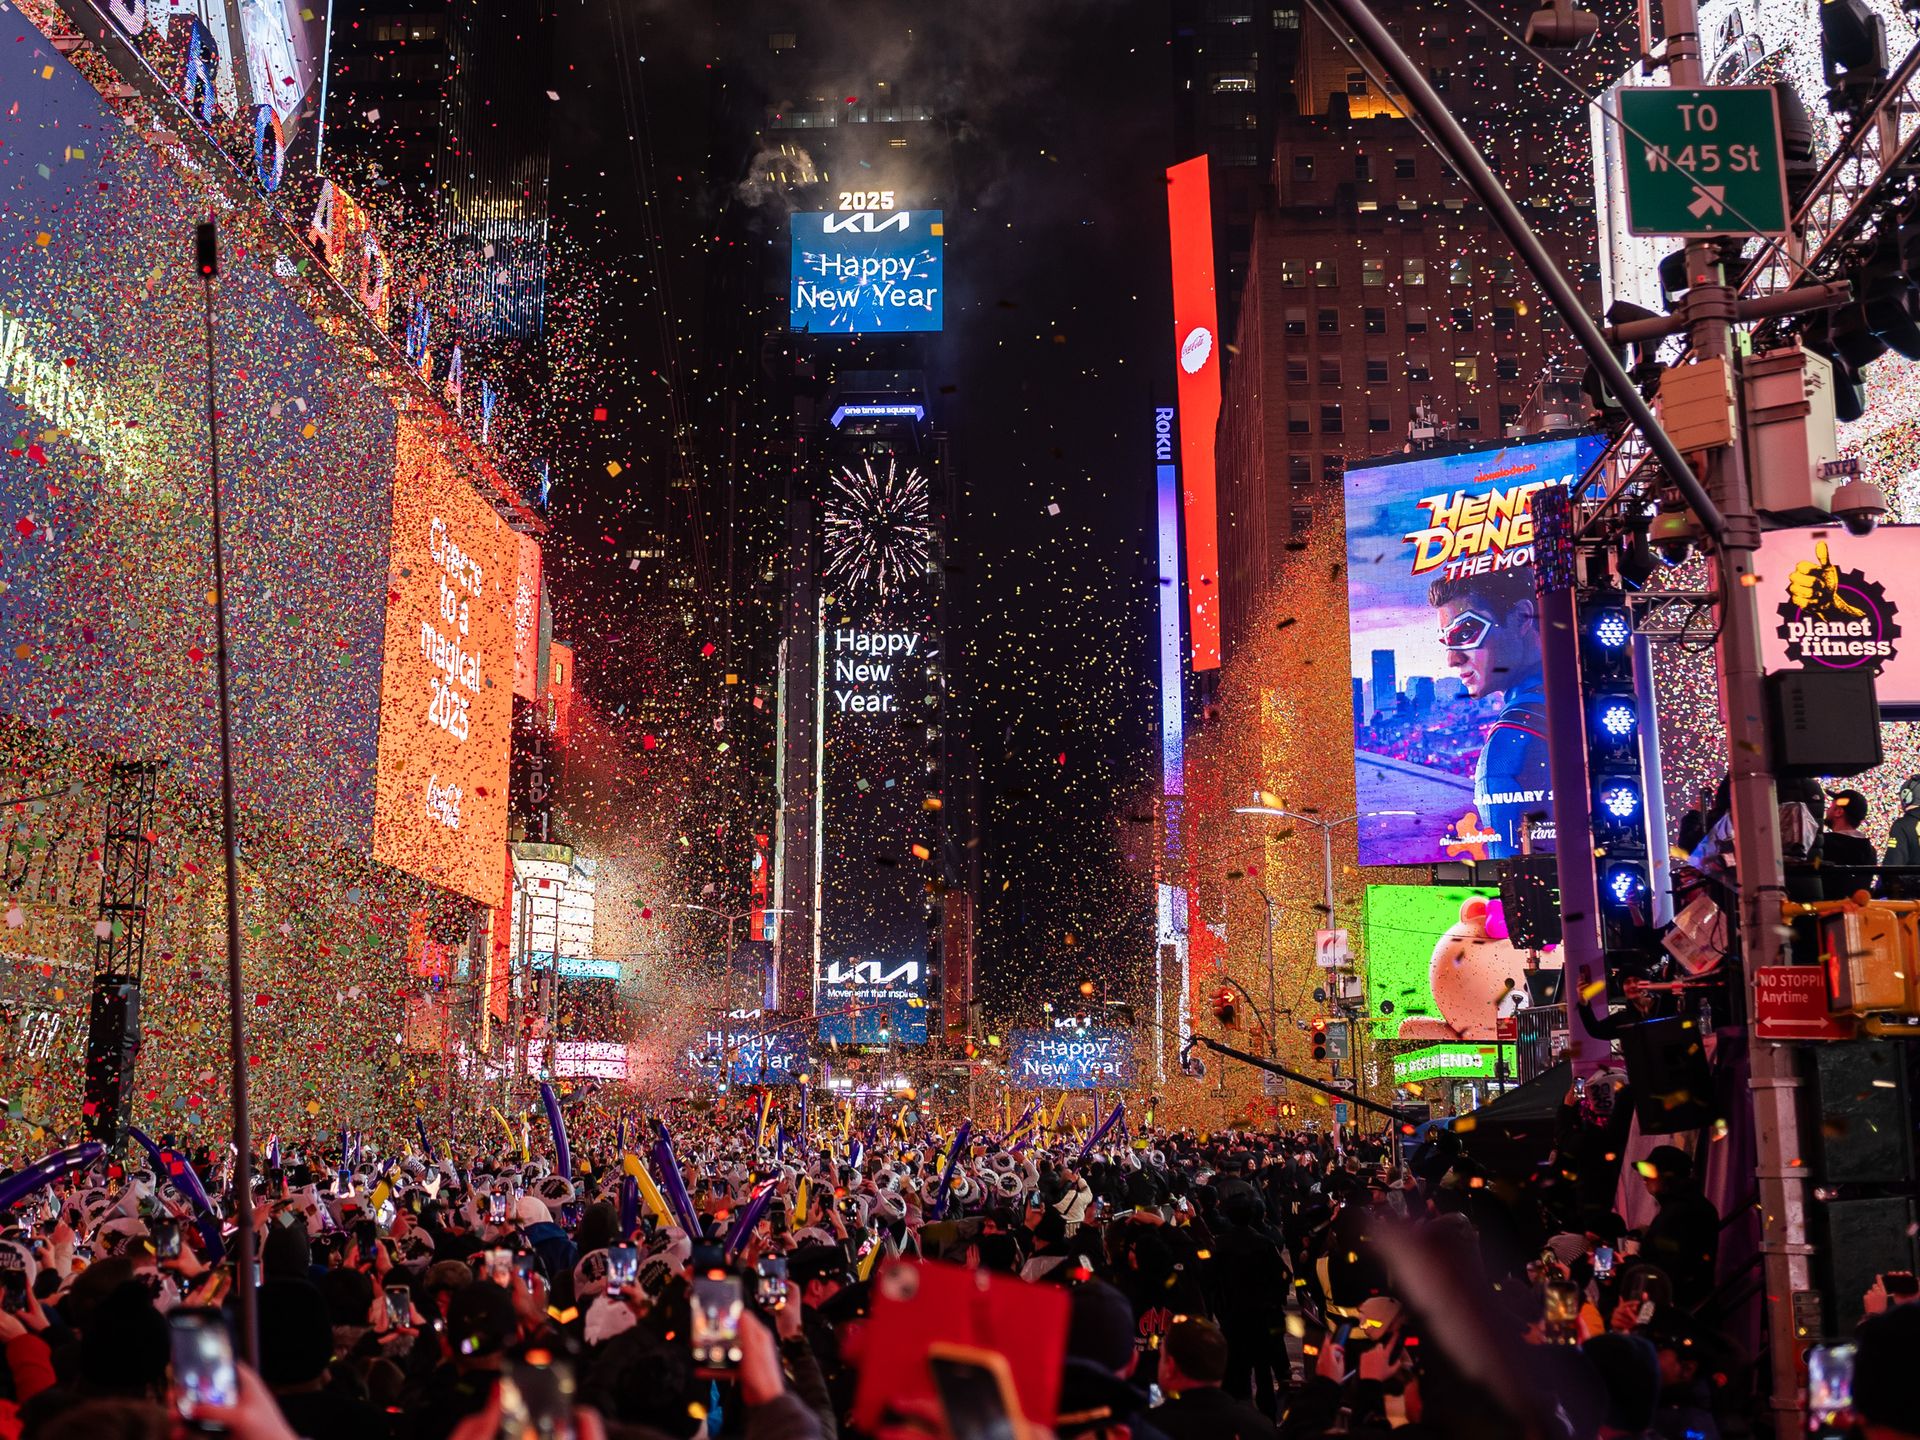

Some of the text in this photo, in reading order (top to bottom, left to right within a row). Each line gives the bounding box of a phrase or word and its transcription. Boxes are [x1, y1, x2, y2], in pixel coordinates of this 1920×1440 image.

[1677, 104, 1718, 131] TO
[1644, 144, 1760, 172] W 45 St
[839, 191, 894, 211] 2025
[823, 211, 910, 233] KIA
[821, 253, 916, 282] Happy
[797, 284, 938, 309] New Year
[886, 406, 916, 416] square
[1823, 459, 1850, 477] NYPD
[430, 516, 482, 598] Cheers
[1446, 554, 1492, 582] THE
[440, 574, 456, 624] to
[1787, 617, 1872, 642] planet
[835, 629, 919, 656] Happy
[1801, 636, 1891, 656] fitness
[421, 620, 480, 696] magical
[836, 659, 891, 682] New
[428, 677, 469, 742] 2025
[834, 690, 897, 712] Year.
[1473, 790, 1545, 805] JANUARY
[1760, 974, 1777, 987] NO
[1762, 991, 1809, 1006] Anytime
[1040, 1040, 1108, 1060] Happy
[1024, 1060, 1070, 1075] New
